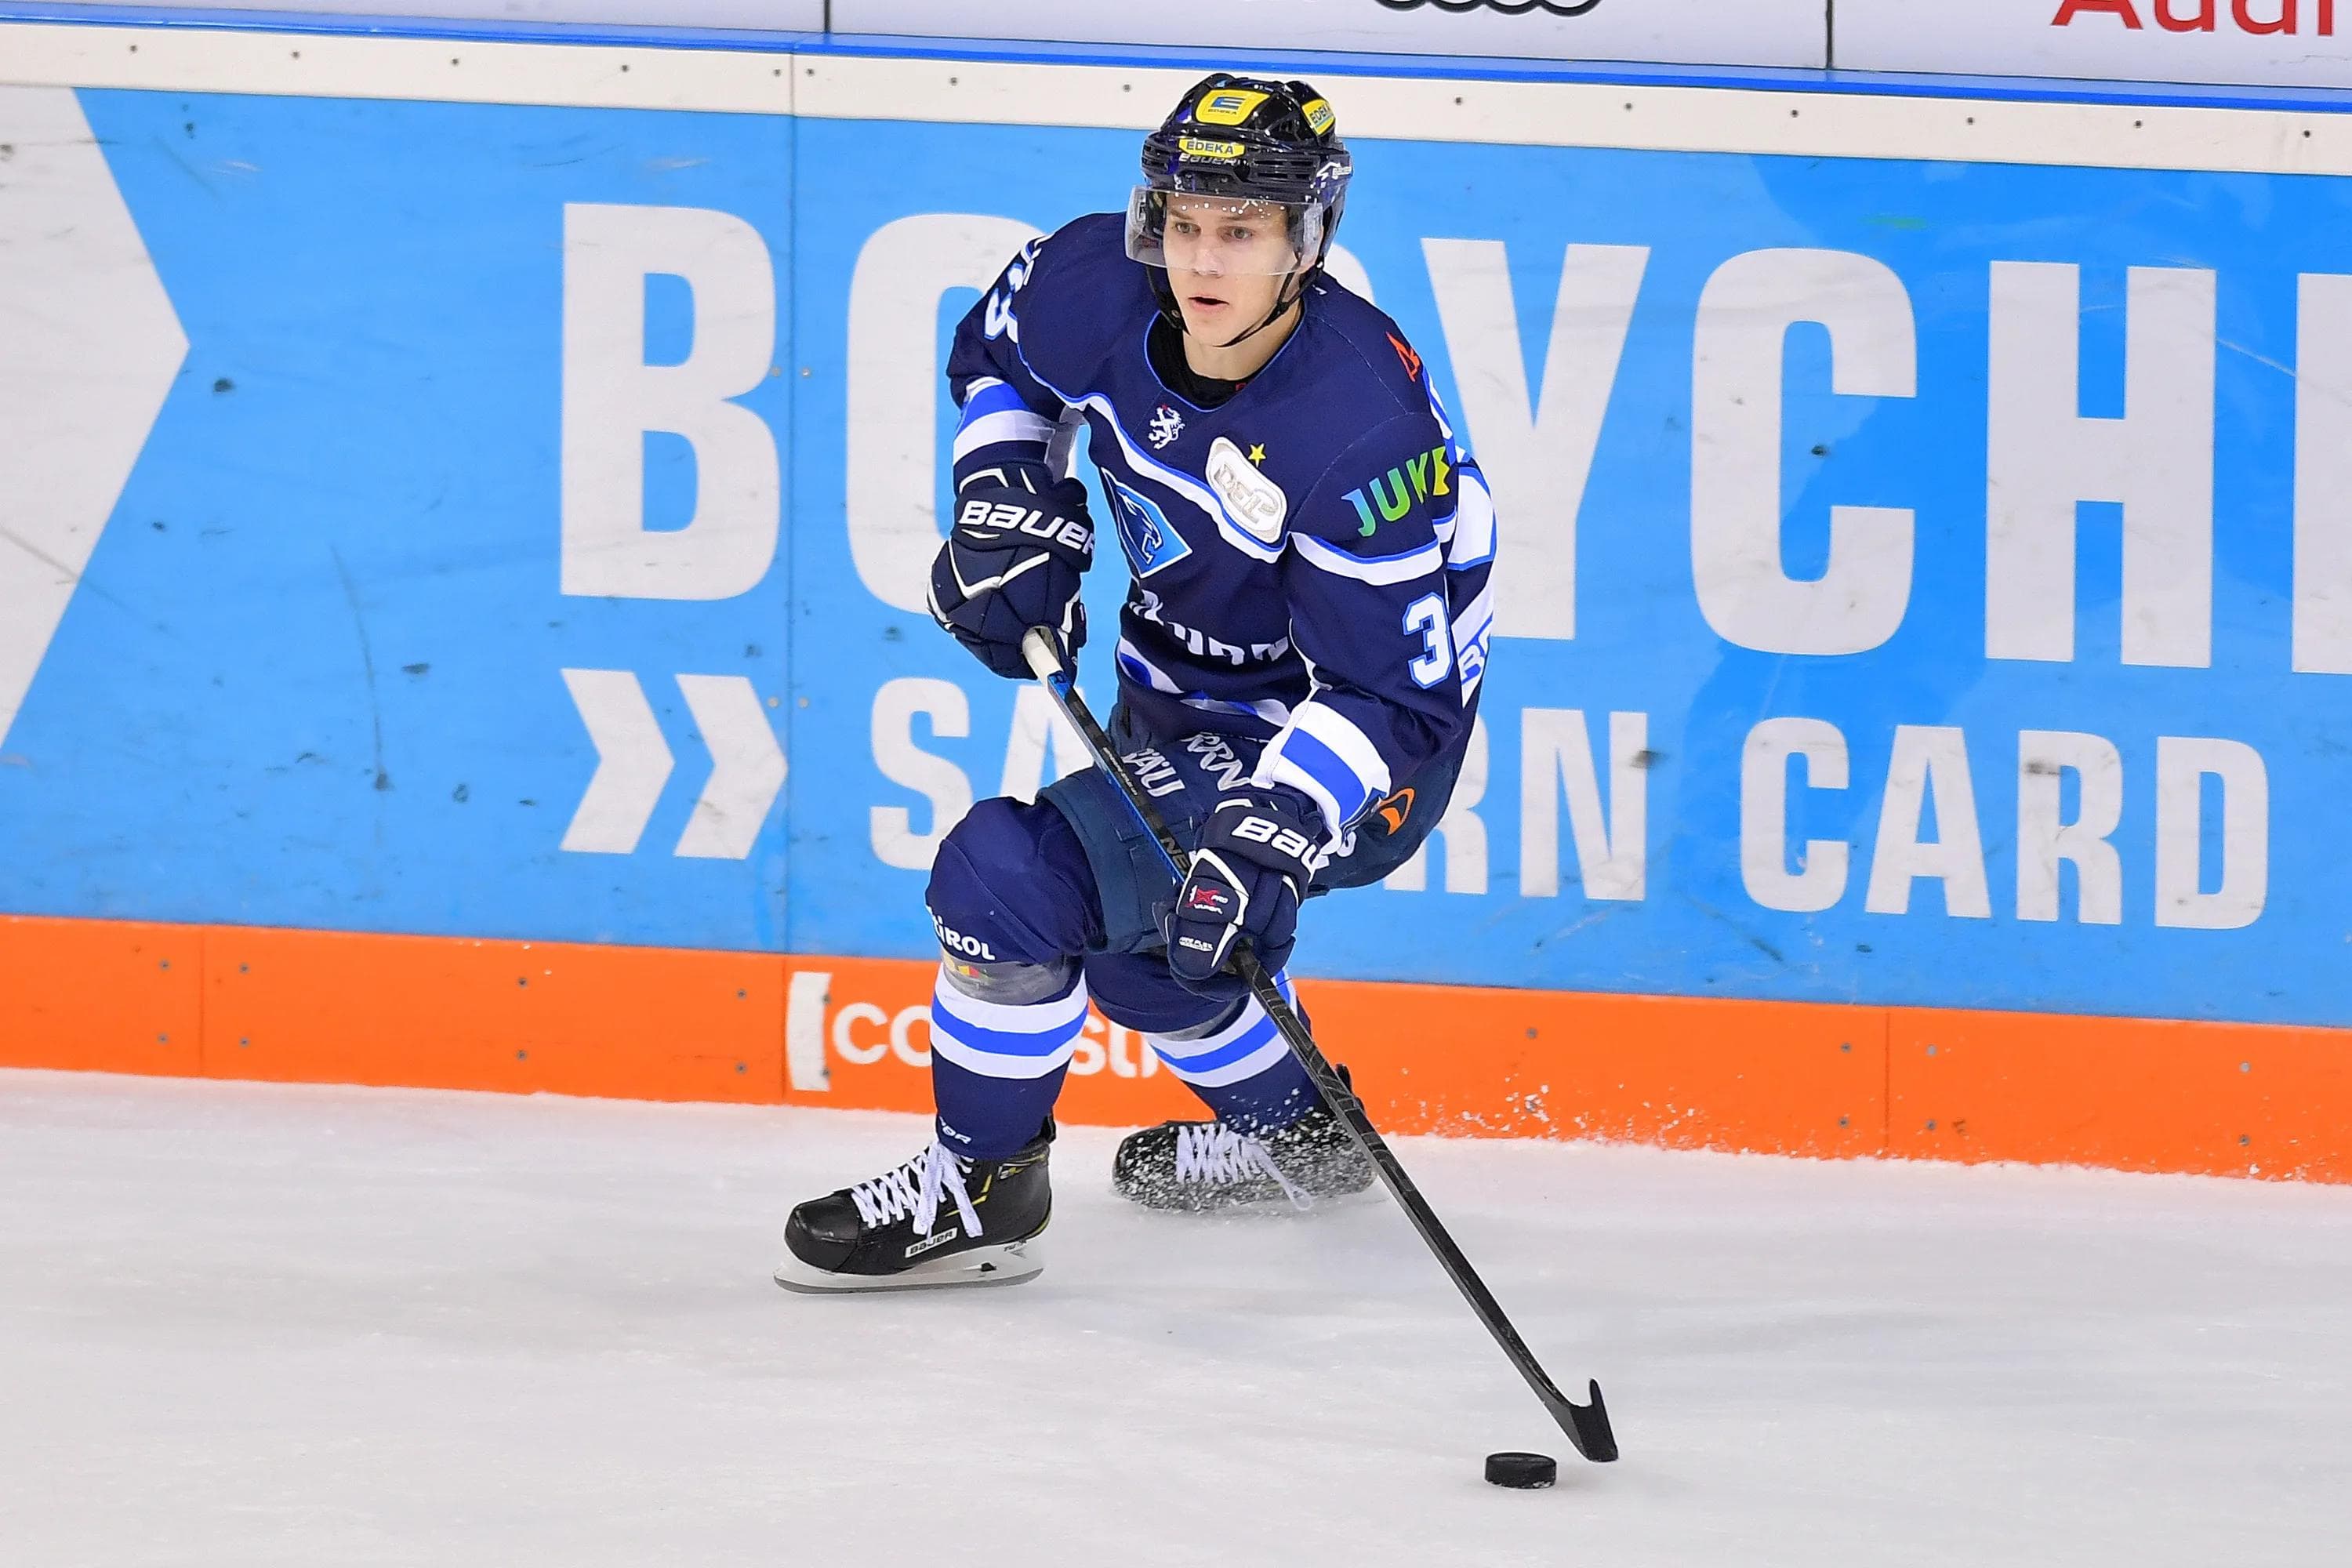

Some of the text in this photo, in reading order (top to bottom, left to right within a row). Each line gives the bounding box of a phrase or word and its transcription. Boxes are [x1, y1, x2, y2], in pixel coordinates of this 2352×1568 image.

[1185, 141, 1234, 154] EDEKA
[560, 202, 2352, 673] BOYCH
[1402, 592, 1454, 690] 3
[870, 677, 2269, 929] SARN CARD
